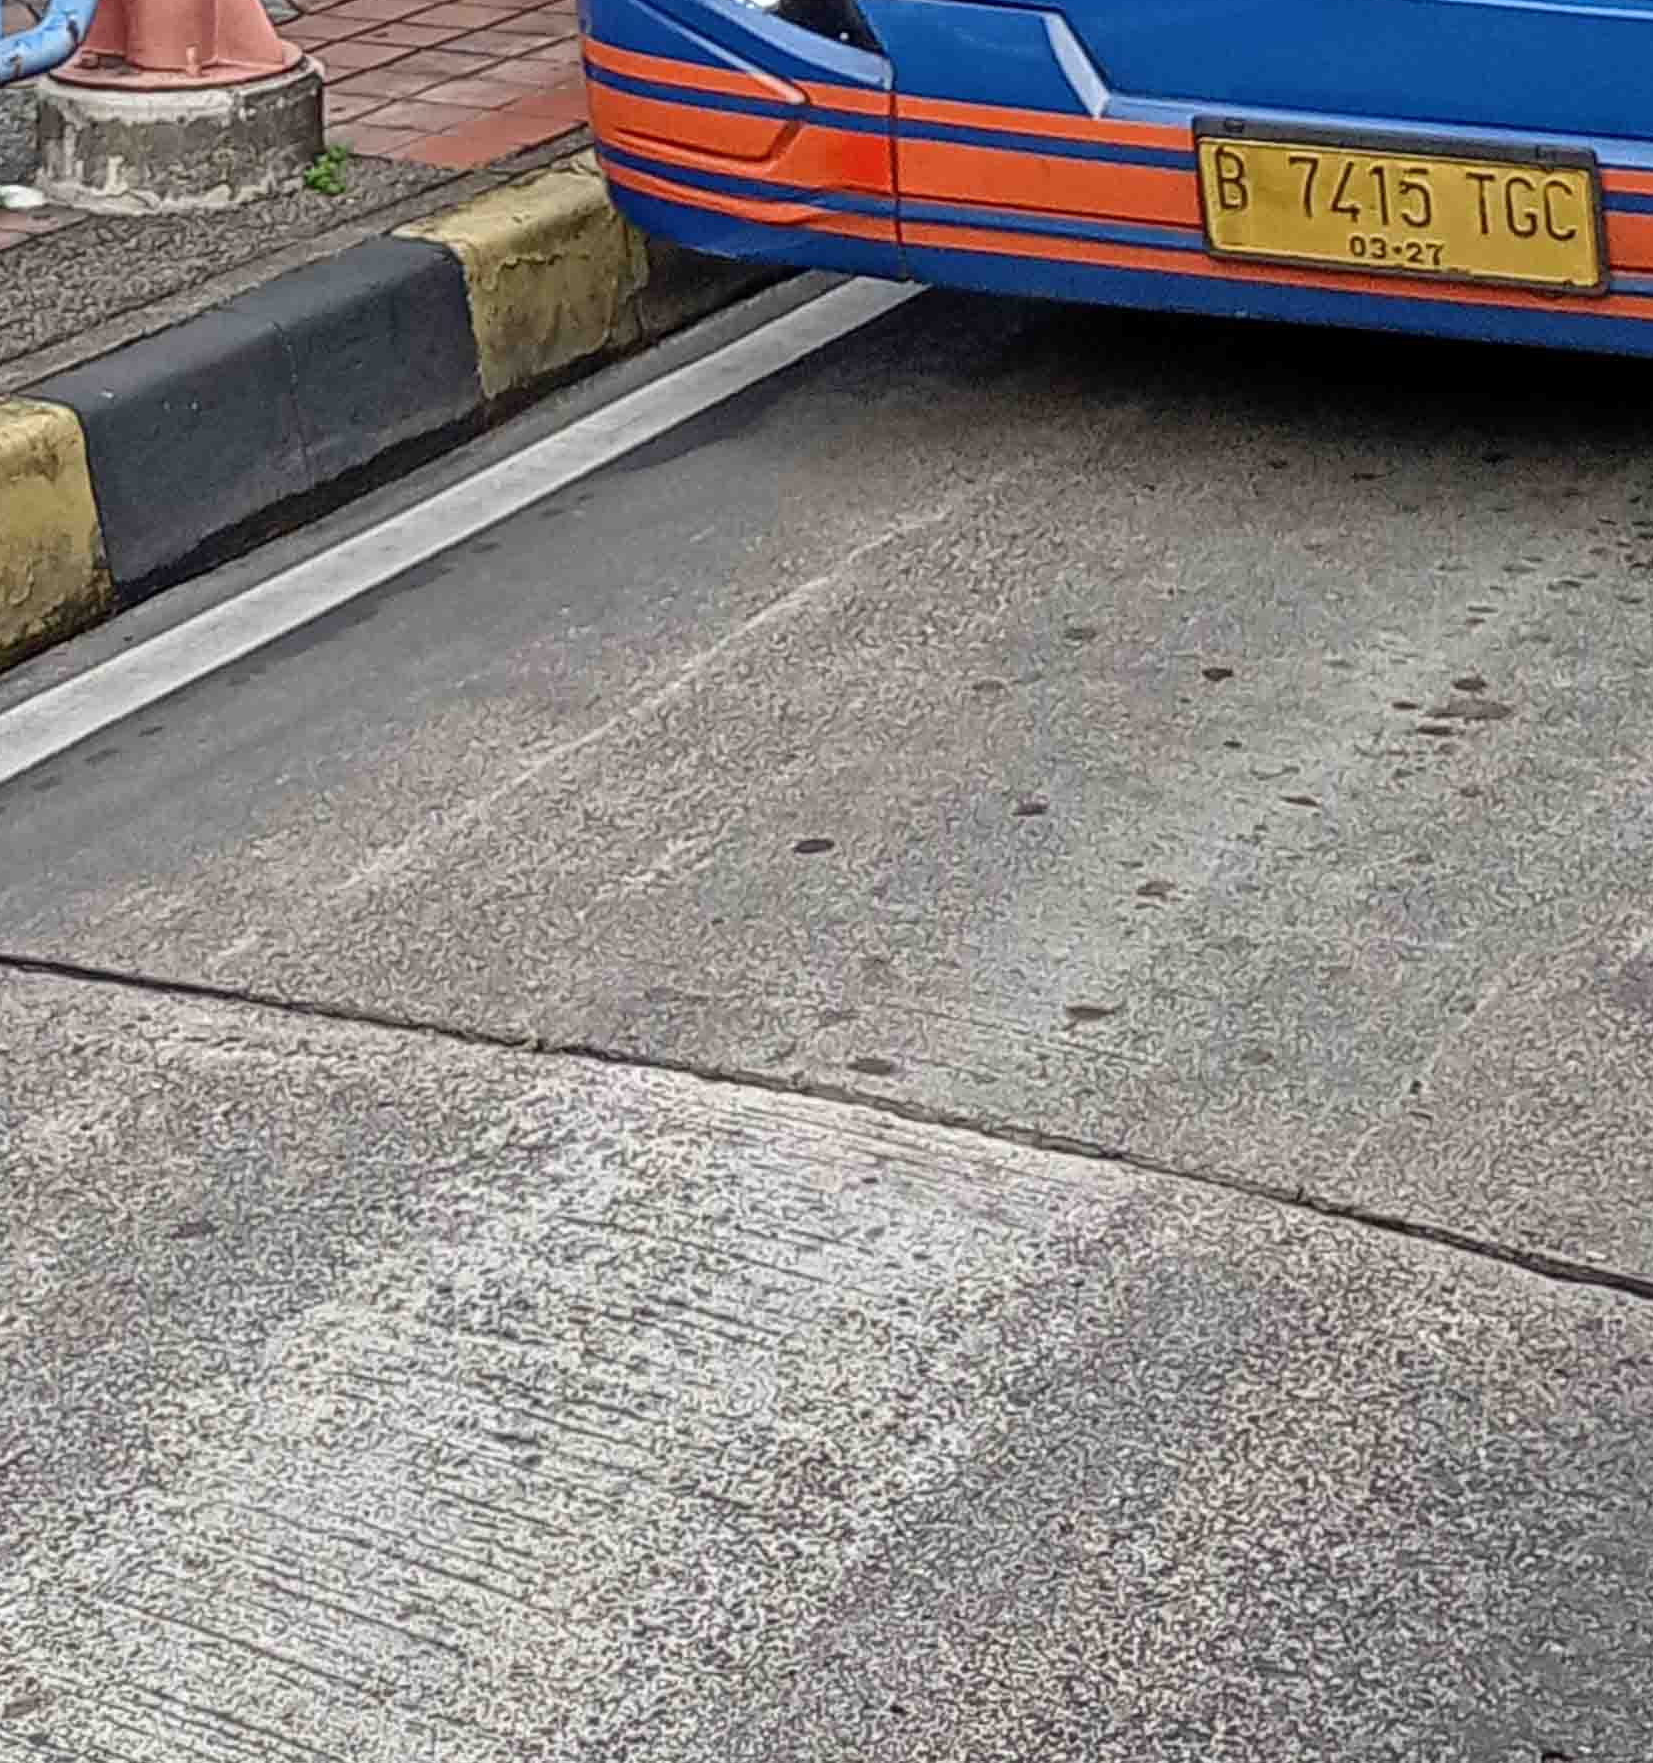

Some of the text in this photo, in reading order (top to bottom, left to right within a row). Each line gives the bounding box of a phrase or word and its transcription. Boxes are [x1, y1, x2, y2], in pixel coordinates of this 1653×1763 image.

[1213, 144, 1578, 241] B 7415 TGC
